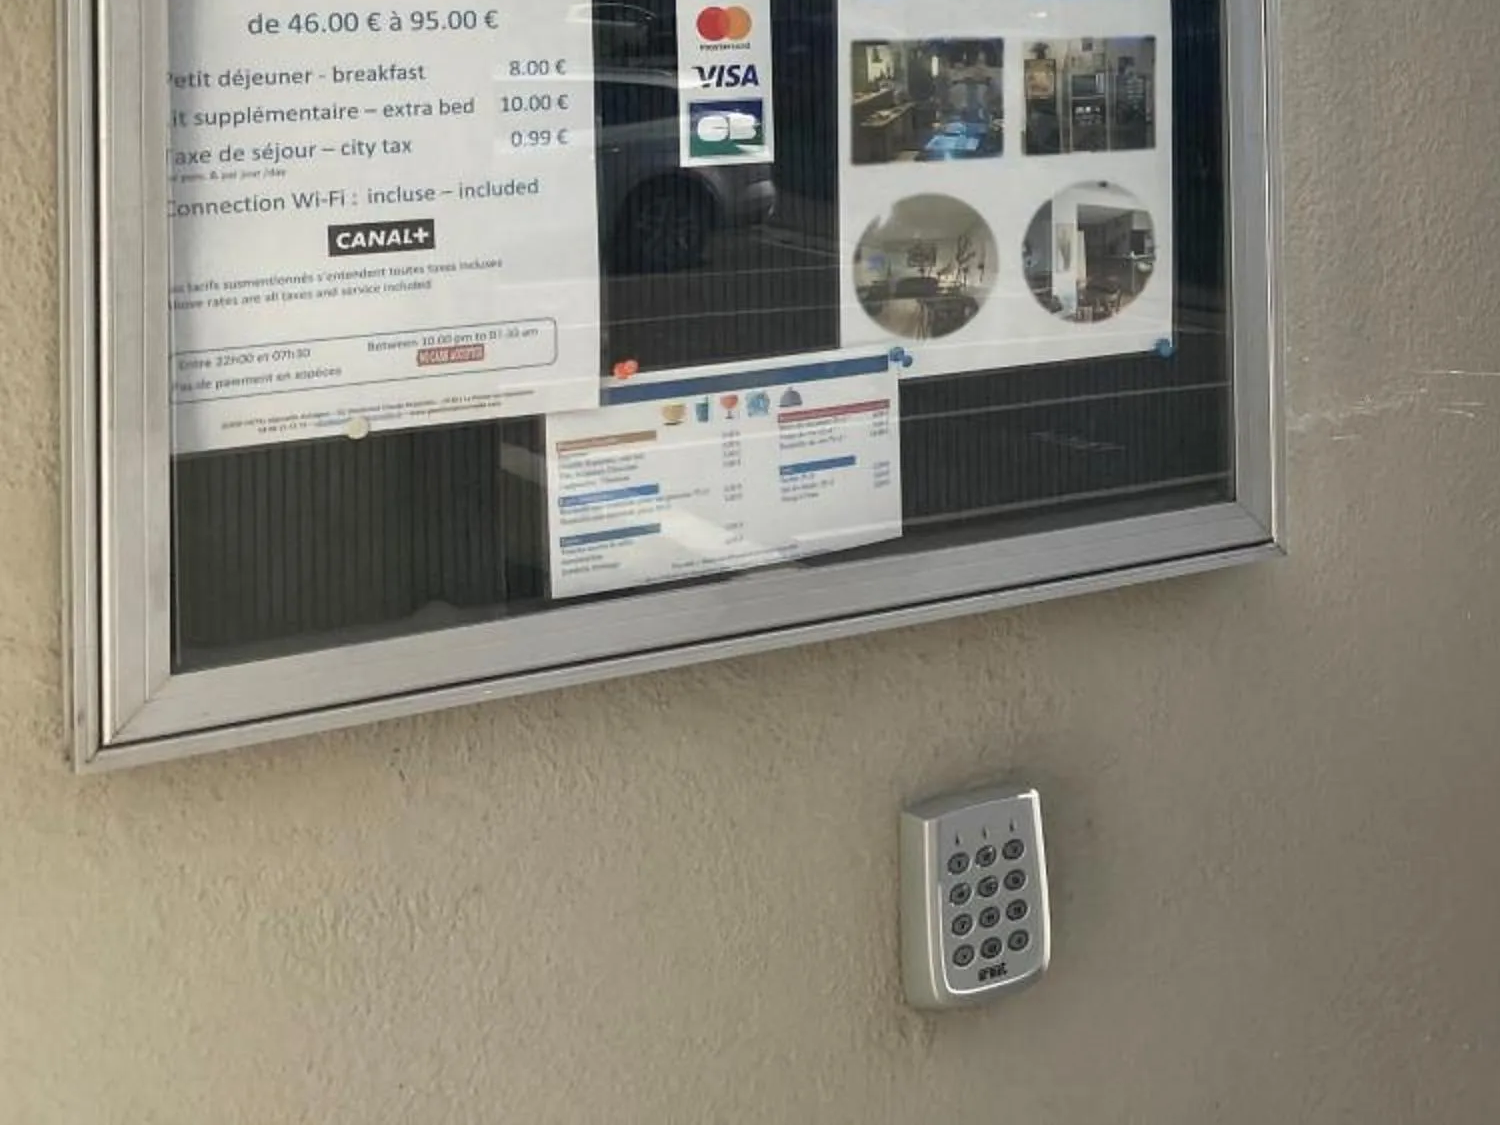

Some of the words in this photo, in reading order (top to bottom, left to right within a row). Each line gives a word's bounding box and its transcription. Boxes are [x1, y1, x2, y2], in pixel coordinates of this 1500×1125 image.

[248, 13, 279, 35] de
[288, 12, 359, 34] 46.00
[368, 12, 381, 31] €
[390, 11, 402, 31] à
[410, 10, 477, 31] 95.00
[484, 9, 499, 30] €
[218, 68, 312, 89] déjeuner
[333, 64, 426, 83] breakfast
[509, 60, 549, 75] 8.00
[556, 59, 567, 75] €
[691, 64, 759, 88] VISA
[172, 109, 187, 126] it
[194, 103, 359, 128] supplémentaire
[383, 101, 433, 117] extra
[439, 98, 475, 114] bed
[501, 94, 551, 112] 10.00
[557, 94, 569, 111] €
[511, 129, 551, 148] 0.99
[557, 127, 569, 145] €
[219, 144, 245, 162] de
[252, 142, 317, 164] séjour
[341, 138, 376, 159] city
[382, 139, 412, 155] tax
[291, 188, 345, 209] Wi-Fi
[367, 186, 436, 204] incluse
[459, 179, 539, 199] included
[336, 226, 429, 250] CANAL+
